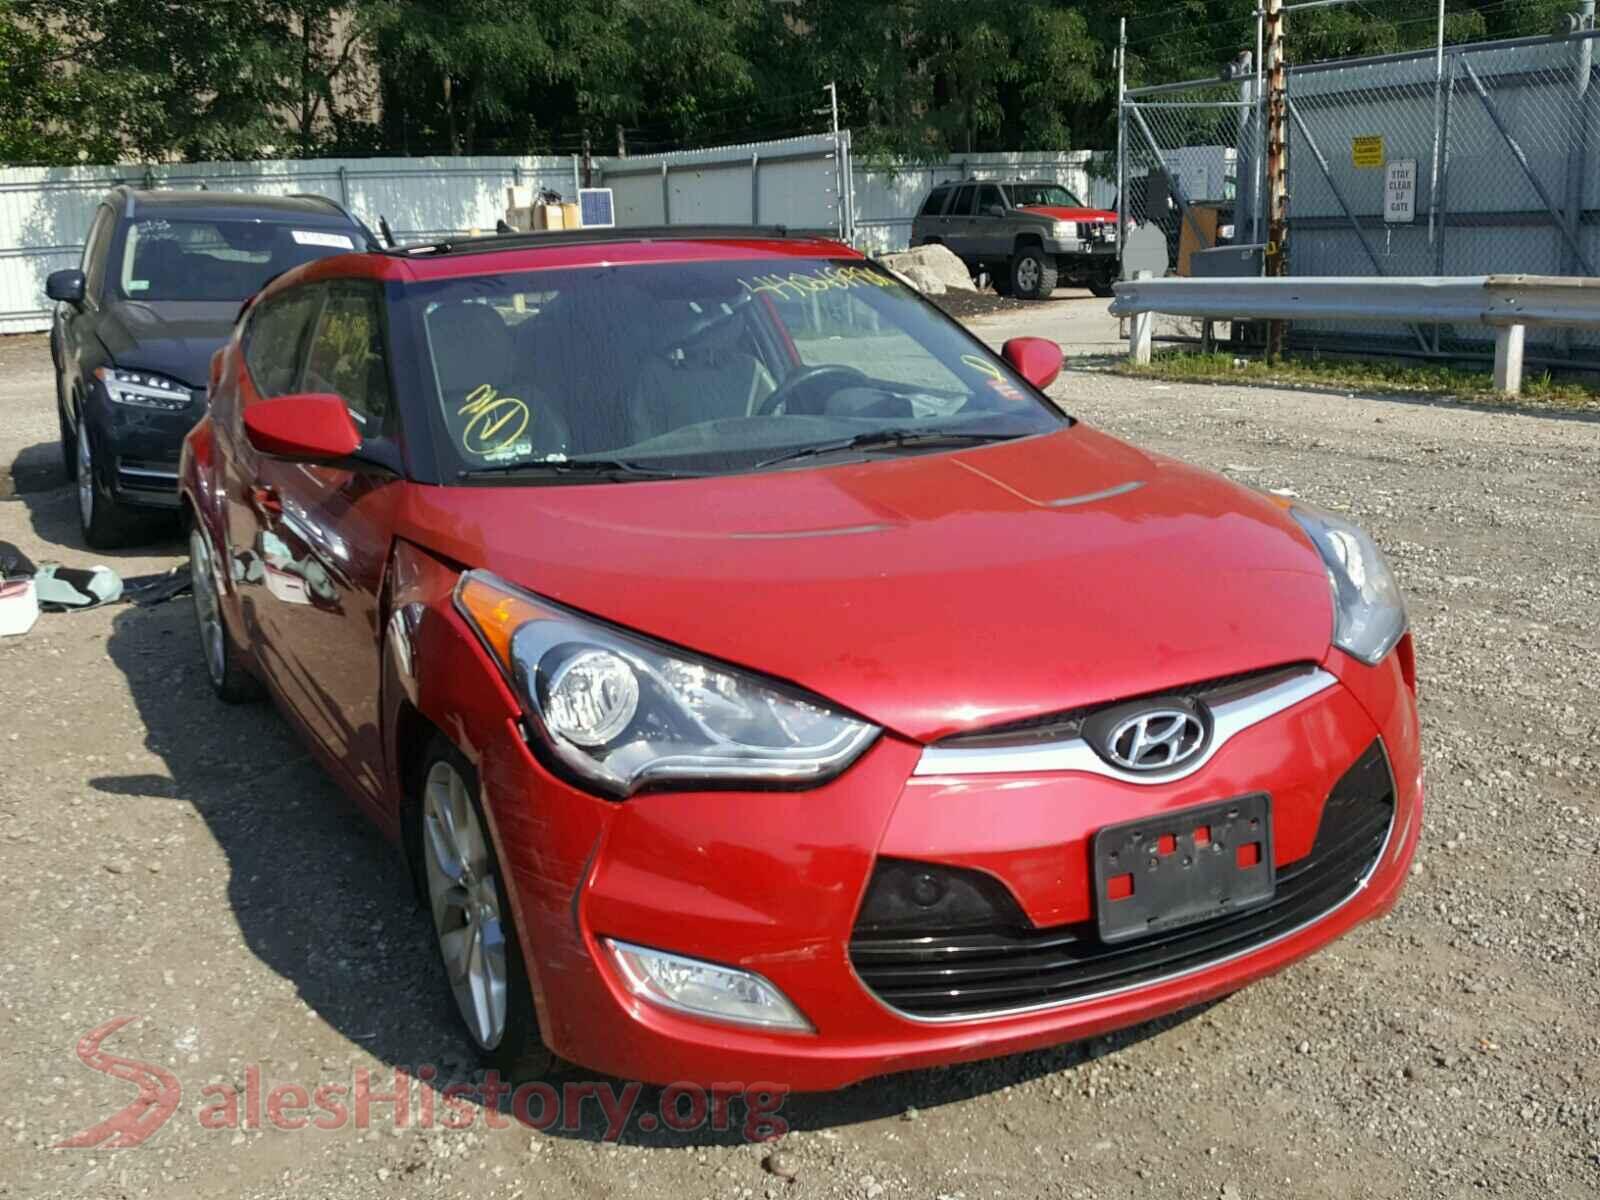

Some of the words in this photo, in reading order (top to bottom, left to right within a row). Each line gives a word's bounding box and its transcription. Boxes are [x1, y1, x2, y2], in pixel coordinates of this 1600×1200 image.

[1392, 170, 1410, 179] STAY
[1389, 180, 1412, 190] CLEAR
[1395, 191, 1405, 201] OF
[1391, 202, 1409, 212] GATE
